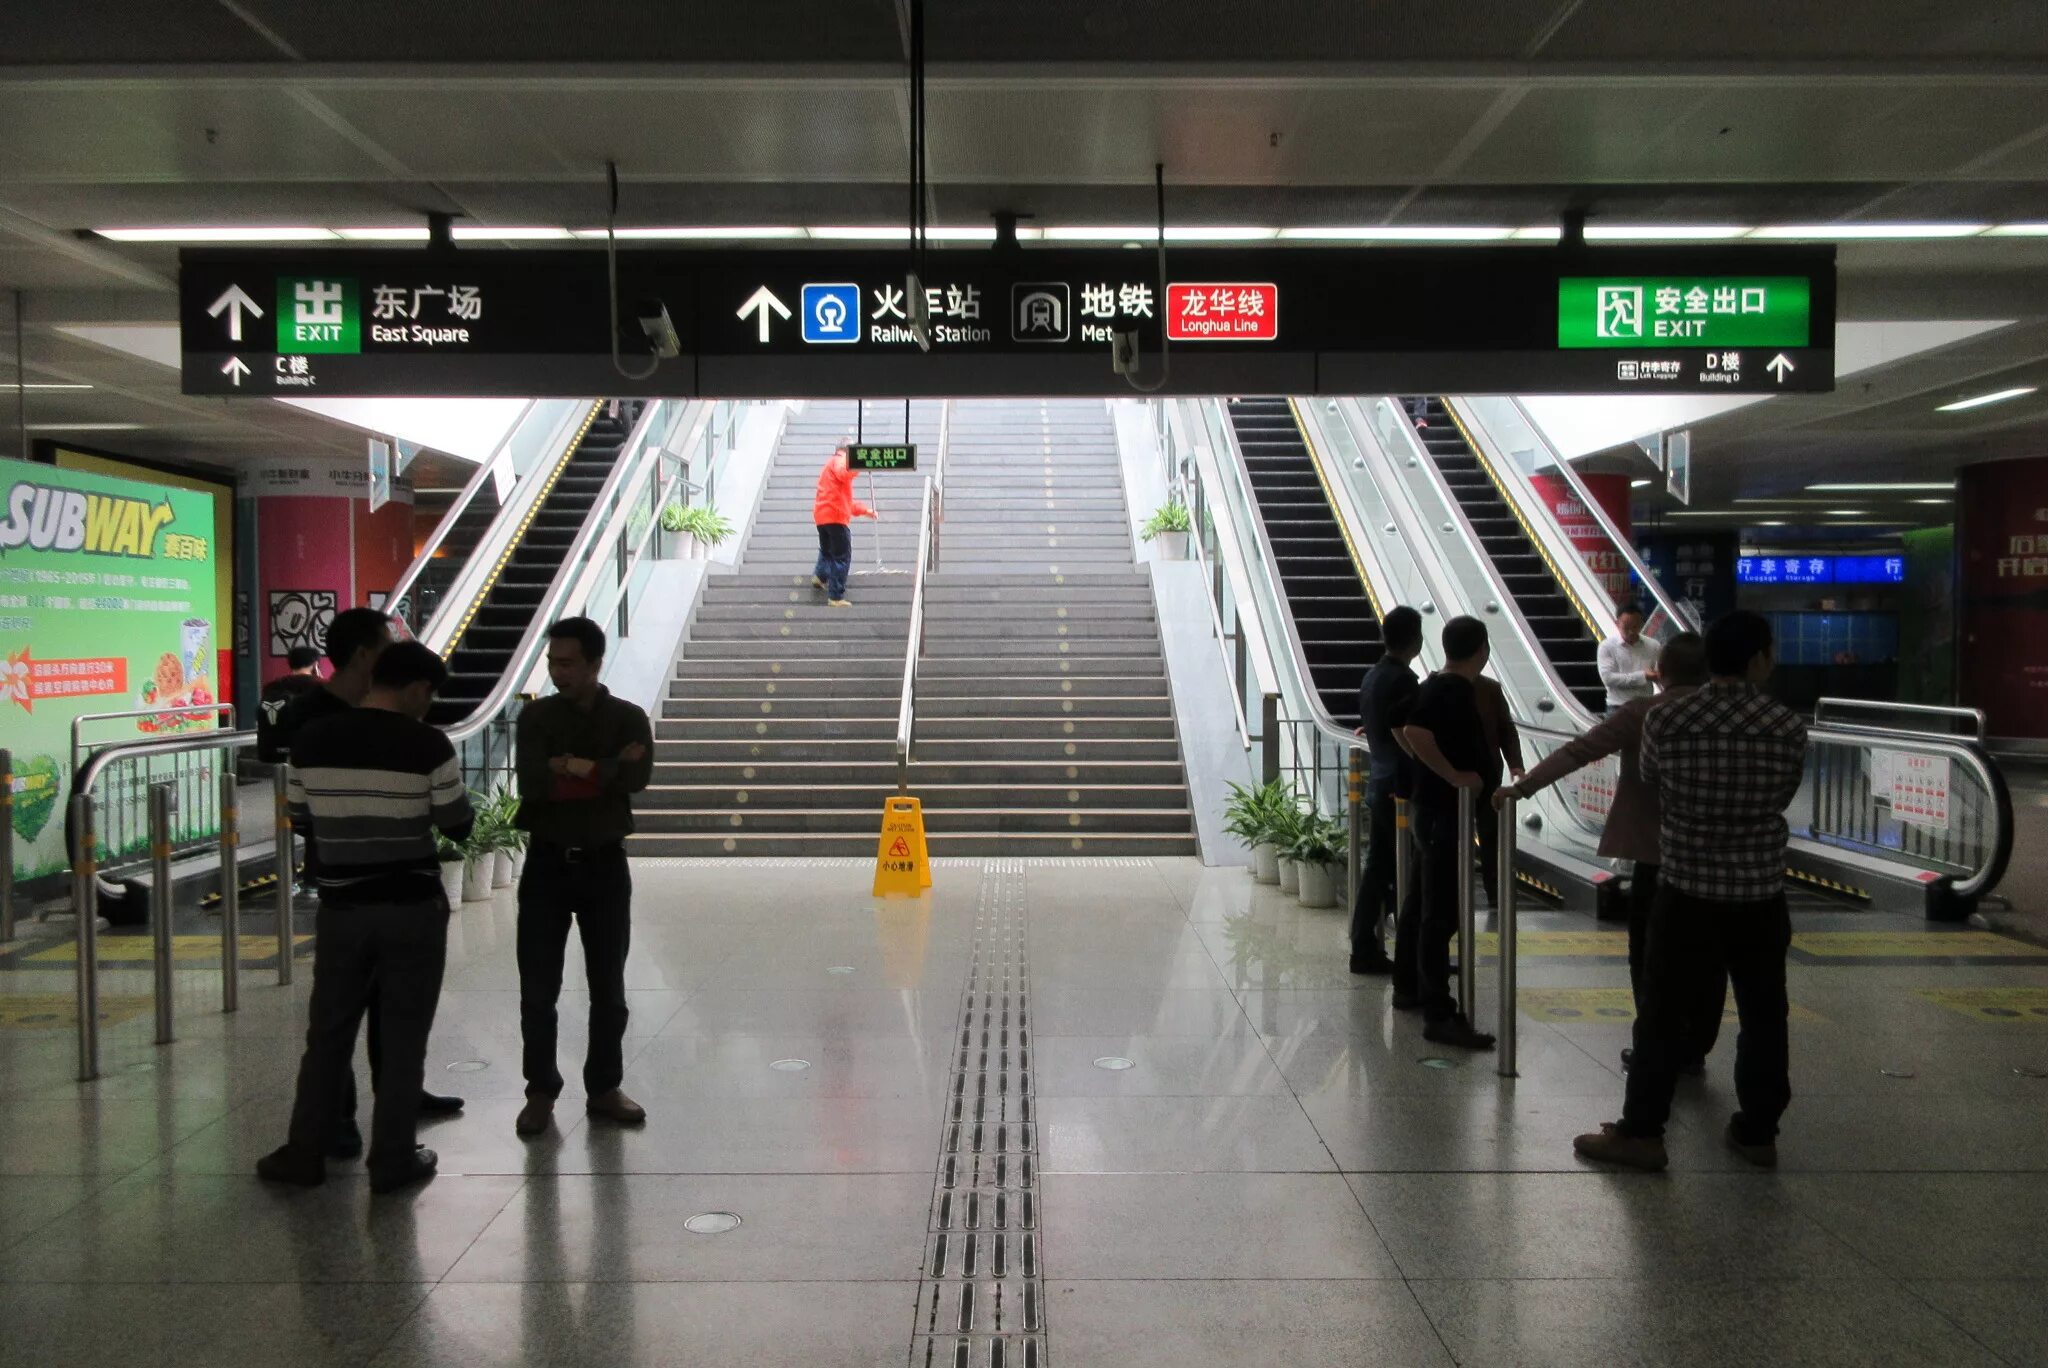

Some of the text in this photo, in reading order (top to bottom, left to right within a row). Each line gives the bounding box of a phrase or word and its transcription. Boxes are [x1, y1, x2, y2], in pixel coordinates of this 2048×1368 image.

[295, 281, 342, 323] 出
[372, 284, 482, 320] 东广场
[1080, 283, 1153, 317] 地铁
[1181, 288, 1264, 316] 龙华线
[1655, 286, 1765, 314] 安全出口
[295, 325, 342, 341] EXIT
[372, 324, 469, 345] East Square
[871, 324, 991, 343] Railw Station
[1081, 324, 1113, 341] Met
[1181, 319, 1258, 334] Longhua Line
[1654, 319, 1706, 337] EXIT
[276, 356, 309, 374] C 楼
[1640, 361, 1680, 373] 行李寄存
[1707, 352, 1740, 371] D 楼
[276, 375, 309, 386] Building
[1700, 372, 1740, 383] Building D
[856, 448, 907, 459] 安全出口
[0, 481, 176, 558] SUBWAY
[163, 533, 208, 561] 赛百味
[1736, 558, 1825, 575] 行李寄存
[1885, 558, 1902, 575] 行
[883, 861, 914, 872] 小心地滑
